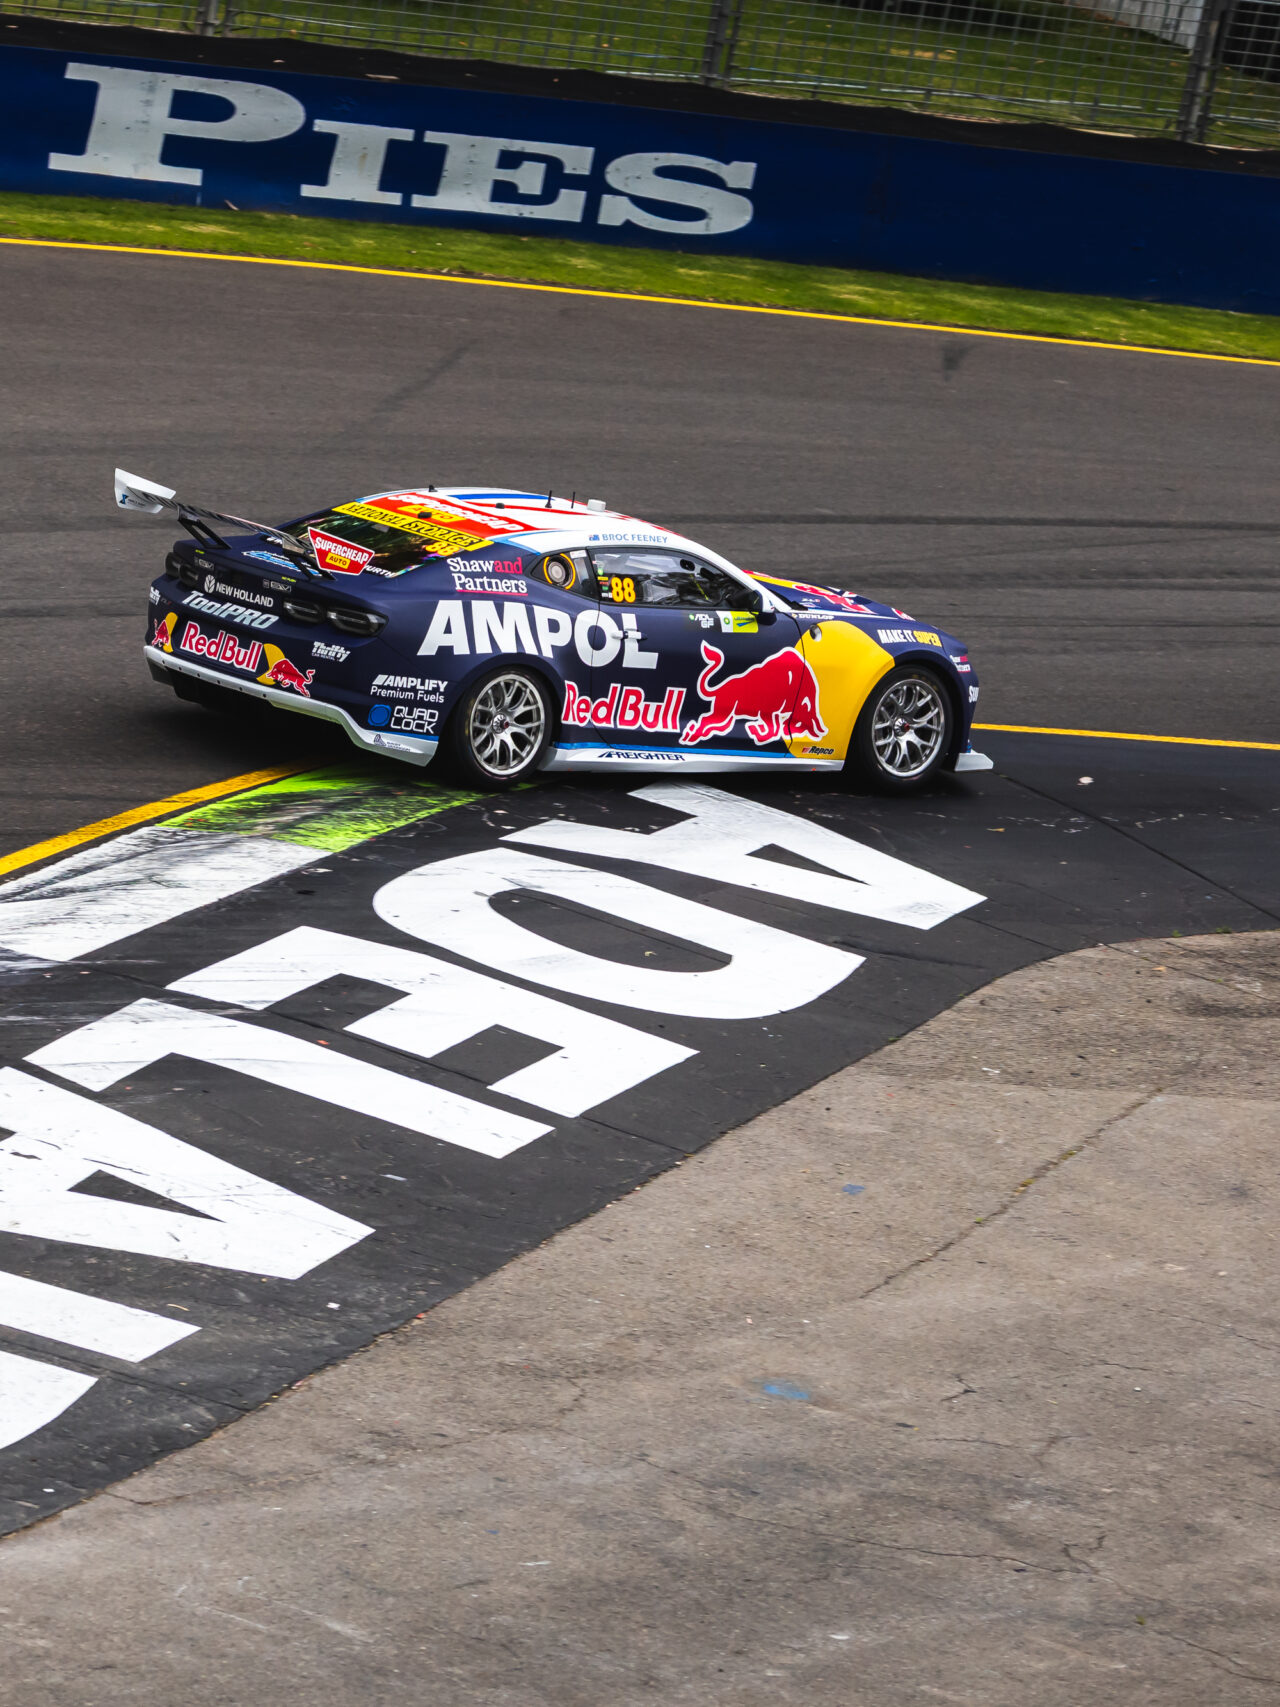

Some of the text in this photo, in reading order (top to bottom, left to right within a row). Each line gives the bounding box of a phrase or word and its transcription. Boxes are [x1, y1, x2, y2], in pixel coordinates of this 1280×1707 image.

[48, 62, 757, 235] PIES
[404, 521, 479, 547] STORAGE
[602, 533, 668, 543] BROC FEENEY
[315, 537, 370, 565] SUPERCHEAP
[425, 541, 460, 556] 88
[329, 555, 348, 566] AUTO
[452, 573, 528, 593] Partners
[610, 576, 636, 603] 88
[216, 582, 274, 608] NEW HOLLAND
[417, 600, 658, 669] AMPOL
[877, 629, 943, 648] MAKE IT SUPER
[383, 675, 448, 692] AMPLIFY
[370, 686, 445, 703] Premium Fuels
[393, 705, 439, 722] QUAD
[390, 717, 437, 734] LOCK
[808, 746, 835, 755] Repco
